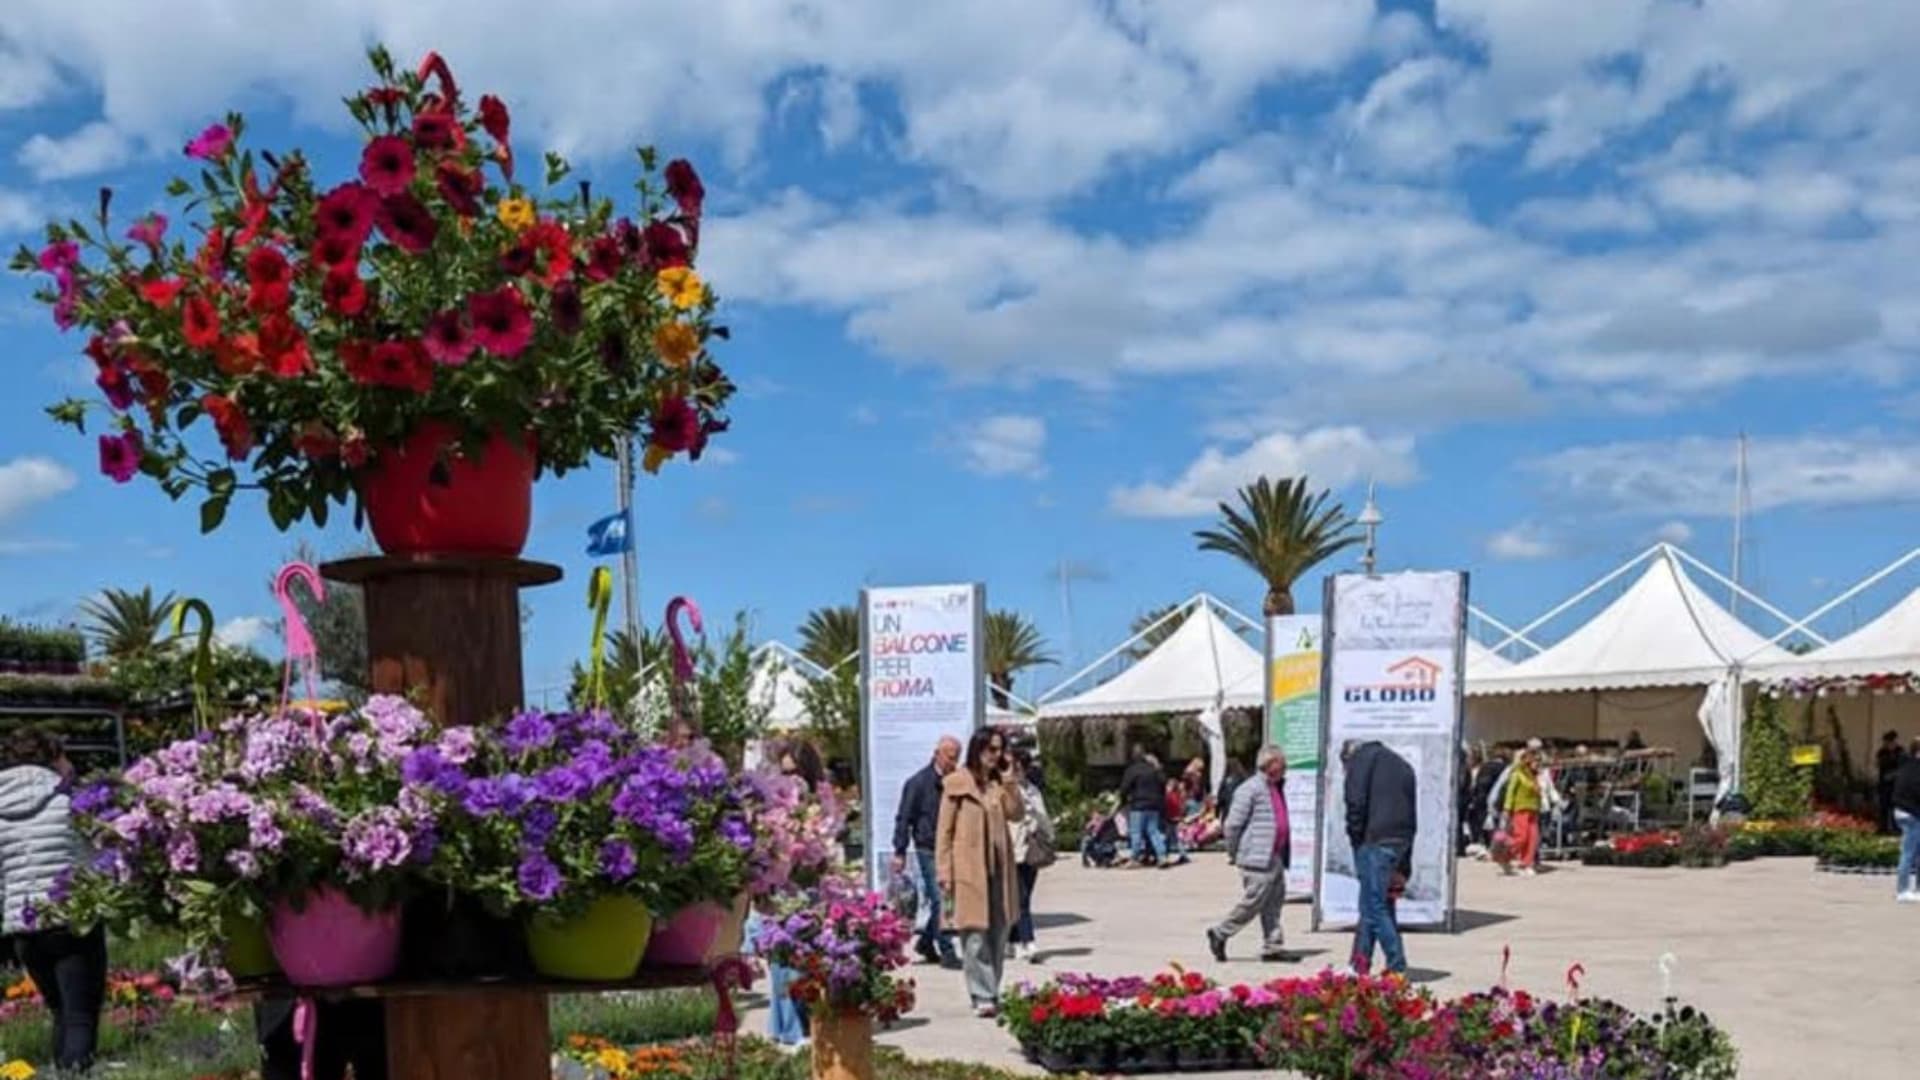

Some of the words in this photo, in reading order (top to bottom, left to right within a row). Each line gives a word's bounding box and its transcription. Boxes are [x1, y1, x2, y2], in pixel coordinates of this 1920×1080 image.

[874, 613, 901, 633] UN
[873, 632, 968, 654] BALCONE
[873, 657, 911, 676] PER
[873, 677, 935, 698] ROMA
[1344, 688, 1436, 702] GLOBO
